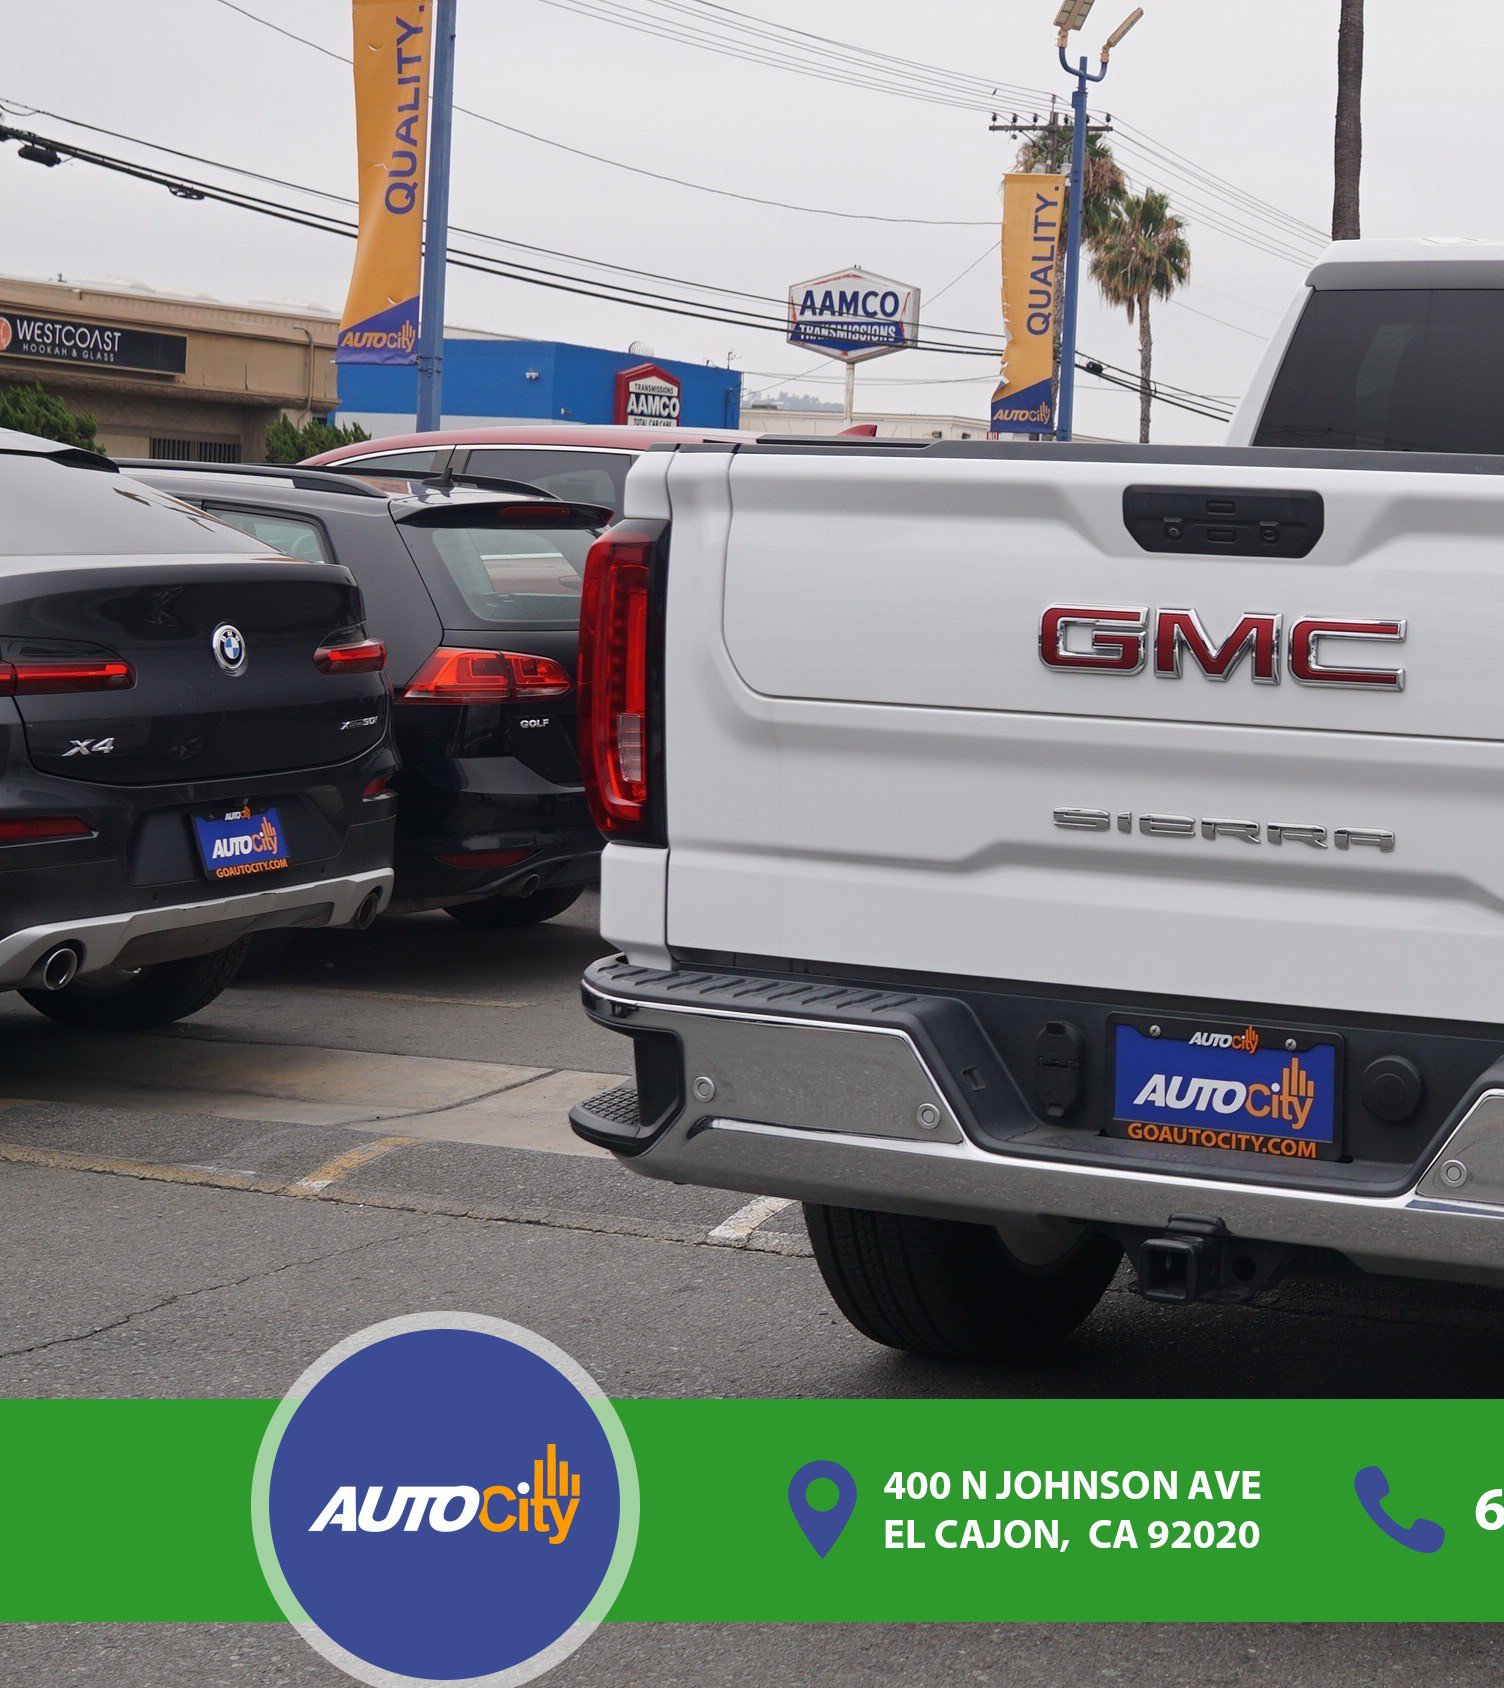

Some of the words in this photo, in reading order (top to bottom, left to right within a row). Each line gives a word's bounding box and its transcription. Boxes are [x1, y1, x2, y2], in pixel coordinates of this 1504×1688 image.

[384, 5, 425, 215] QUALITY.
[1026, 186, 1060, 336] QUALITY.
[799, 289, 900, 318] AAMCO
[16, 318, 122, 352] WESTCOAST
[799, 323, 897, 342] TRANSMISSIONS
[23, 342, 68, 357] HOOKAH
[71, 349, 78, 358] &
[82, 350, 115, 362] GLASS
[634, 383, 674, 395] TRANSMISSIONS
[626, 393, 680, 418] AAMCO
[1038, 602, 1408, 692] GMC
[520, 718, 550, 729] GOLF
[62, 737, 115, 757] X4
[1053, 806, 1396, 854] SIERRA
[216, 858, 288, 878] GOAUTOCITY.COM
[1127, 1121, 1317, 1159] GOAUTOCITY.COM
